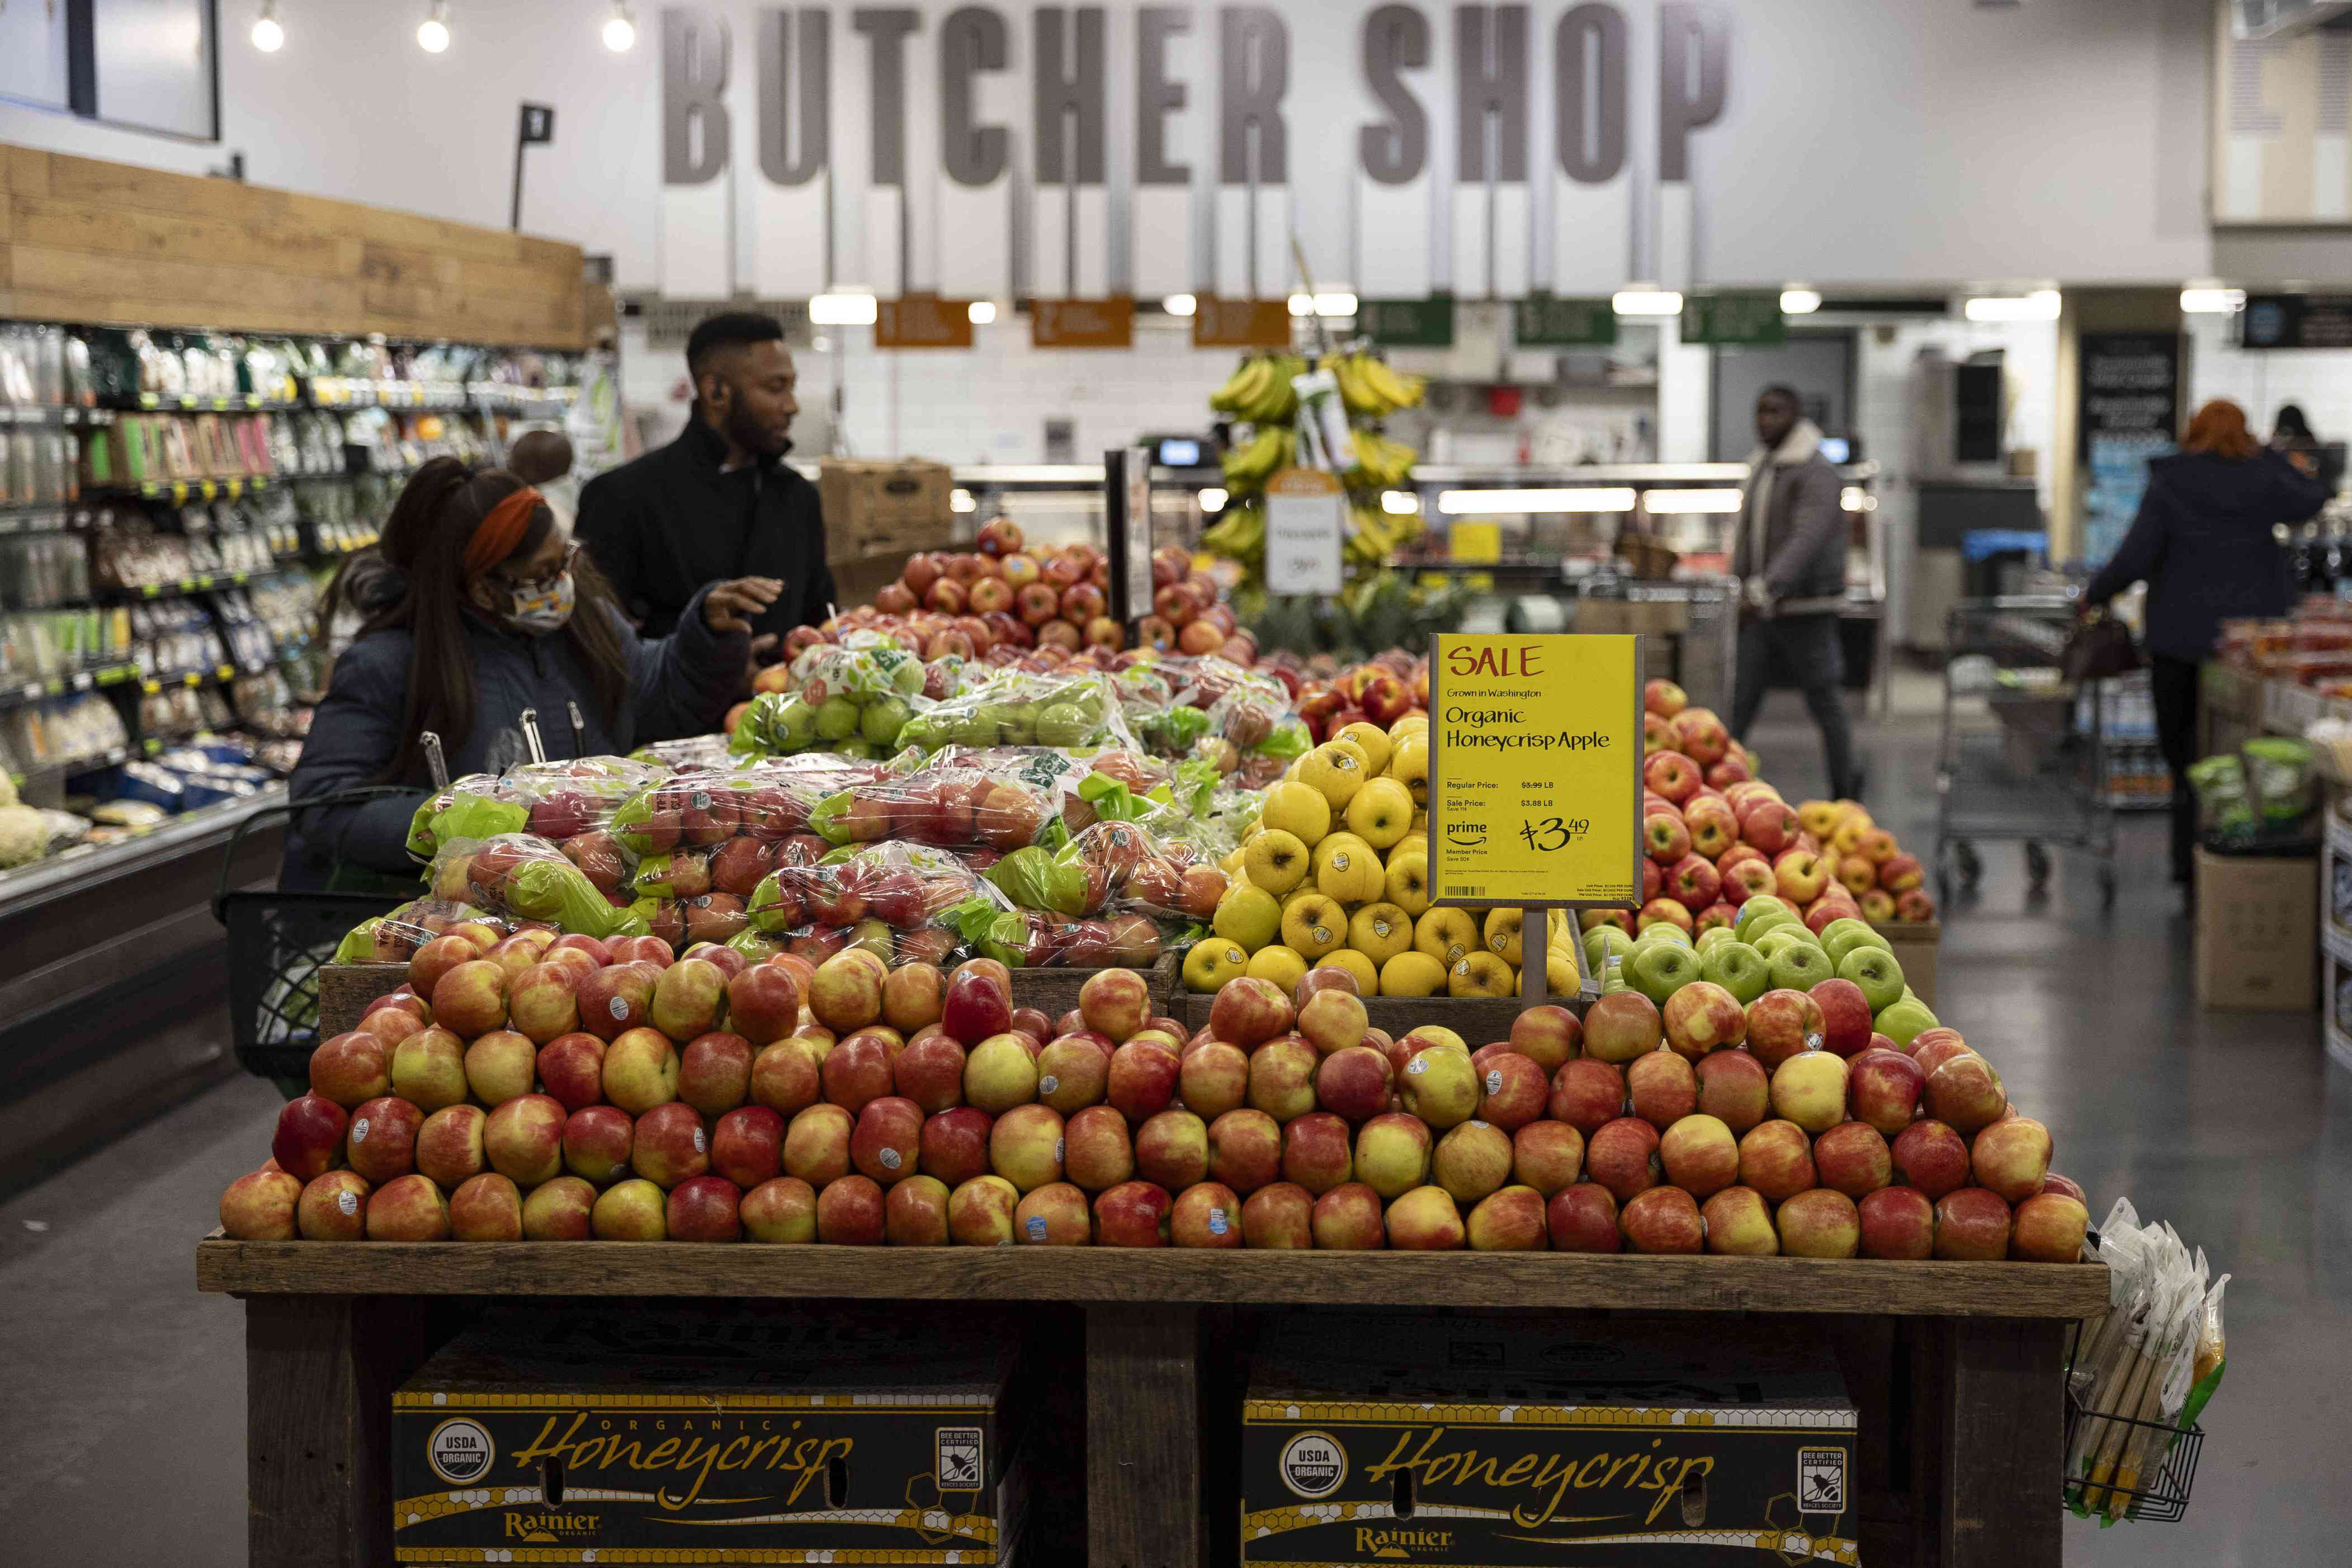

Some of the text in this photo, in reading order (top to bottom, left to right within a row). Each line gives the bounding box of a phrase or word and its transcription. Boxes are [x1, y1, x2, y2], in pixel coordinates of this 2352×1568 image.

[662, 3, 1731, 188] BUTCHER SHOP
[1447, 645, 1544, 677] SALE
[1447, 688, 1477, 697] Grown
[1488, 688, 1542, 700] Washington
[1446, 707, 1527, 729] Organic
[1447, 729, 1610, 752] Honeycrisp Apple
[1447, 820, 1487, 835] prime
[601, 1419, 771, 1431] ORGANIC
[446, 1436, 477, 1449] USDA
[442, 1453, 481, 1463] ORGANIC
[511, 1412, 854, 1510] Honeycrisp
[1298, 1449, 1330, 1462] USDA
[1295, 1466, 1334, 1477] ORGANIC
[1364, 1427, 1715, 1529] Honeycrisp
[503, 1512, 600, 1537] Rainier
[1356, 1527, 1453, 1553] Rainier
